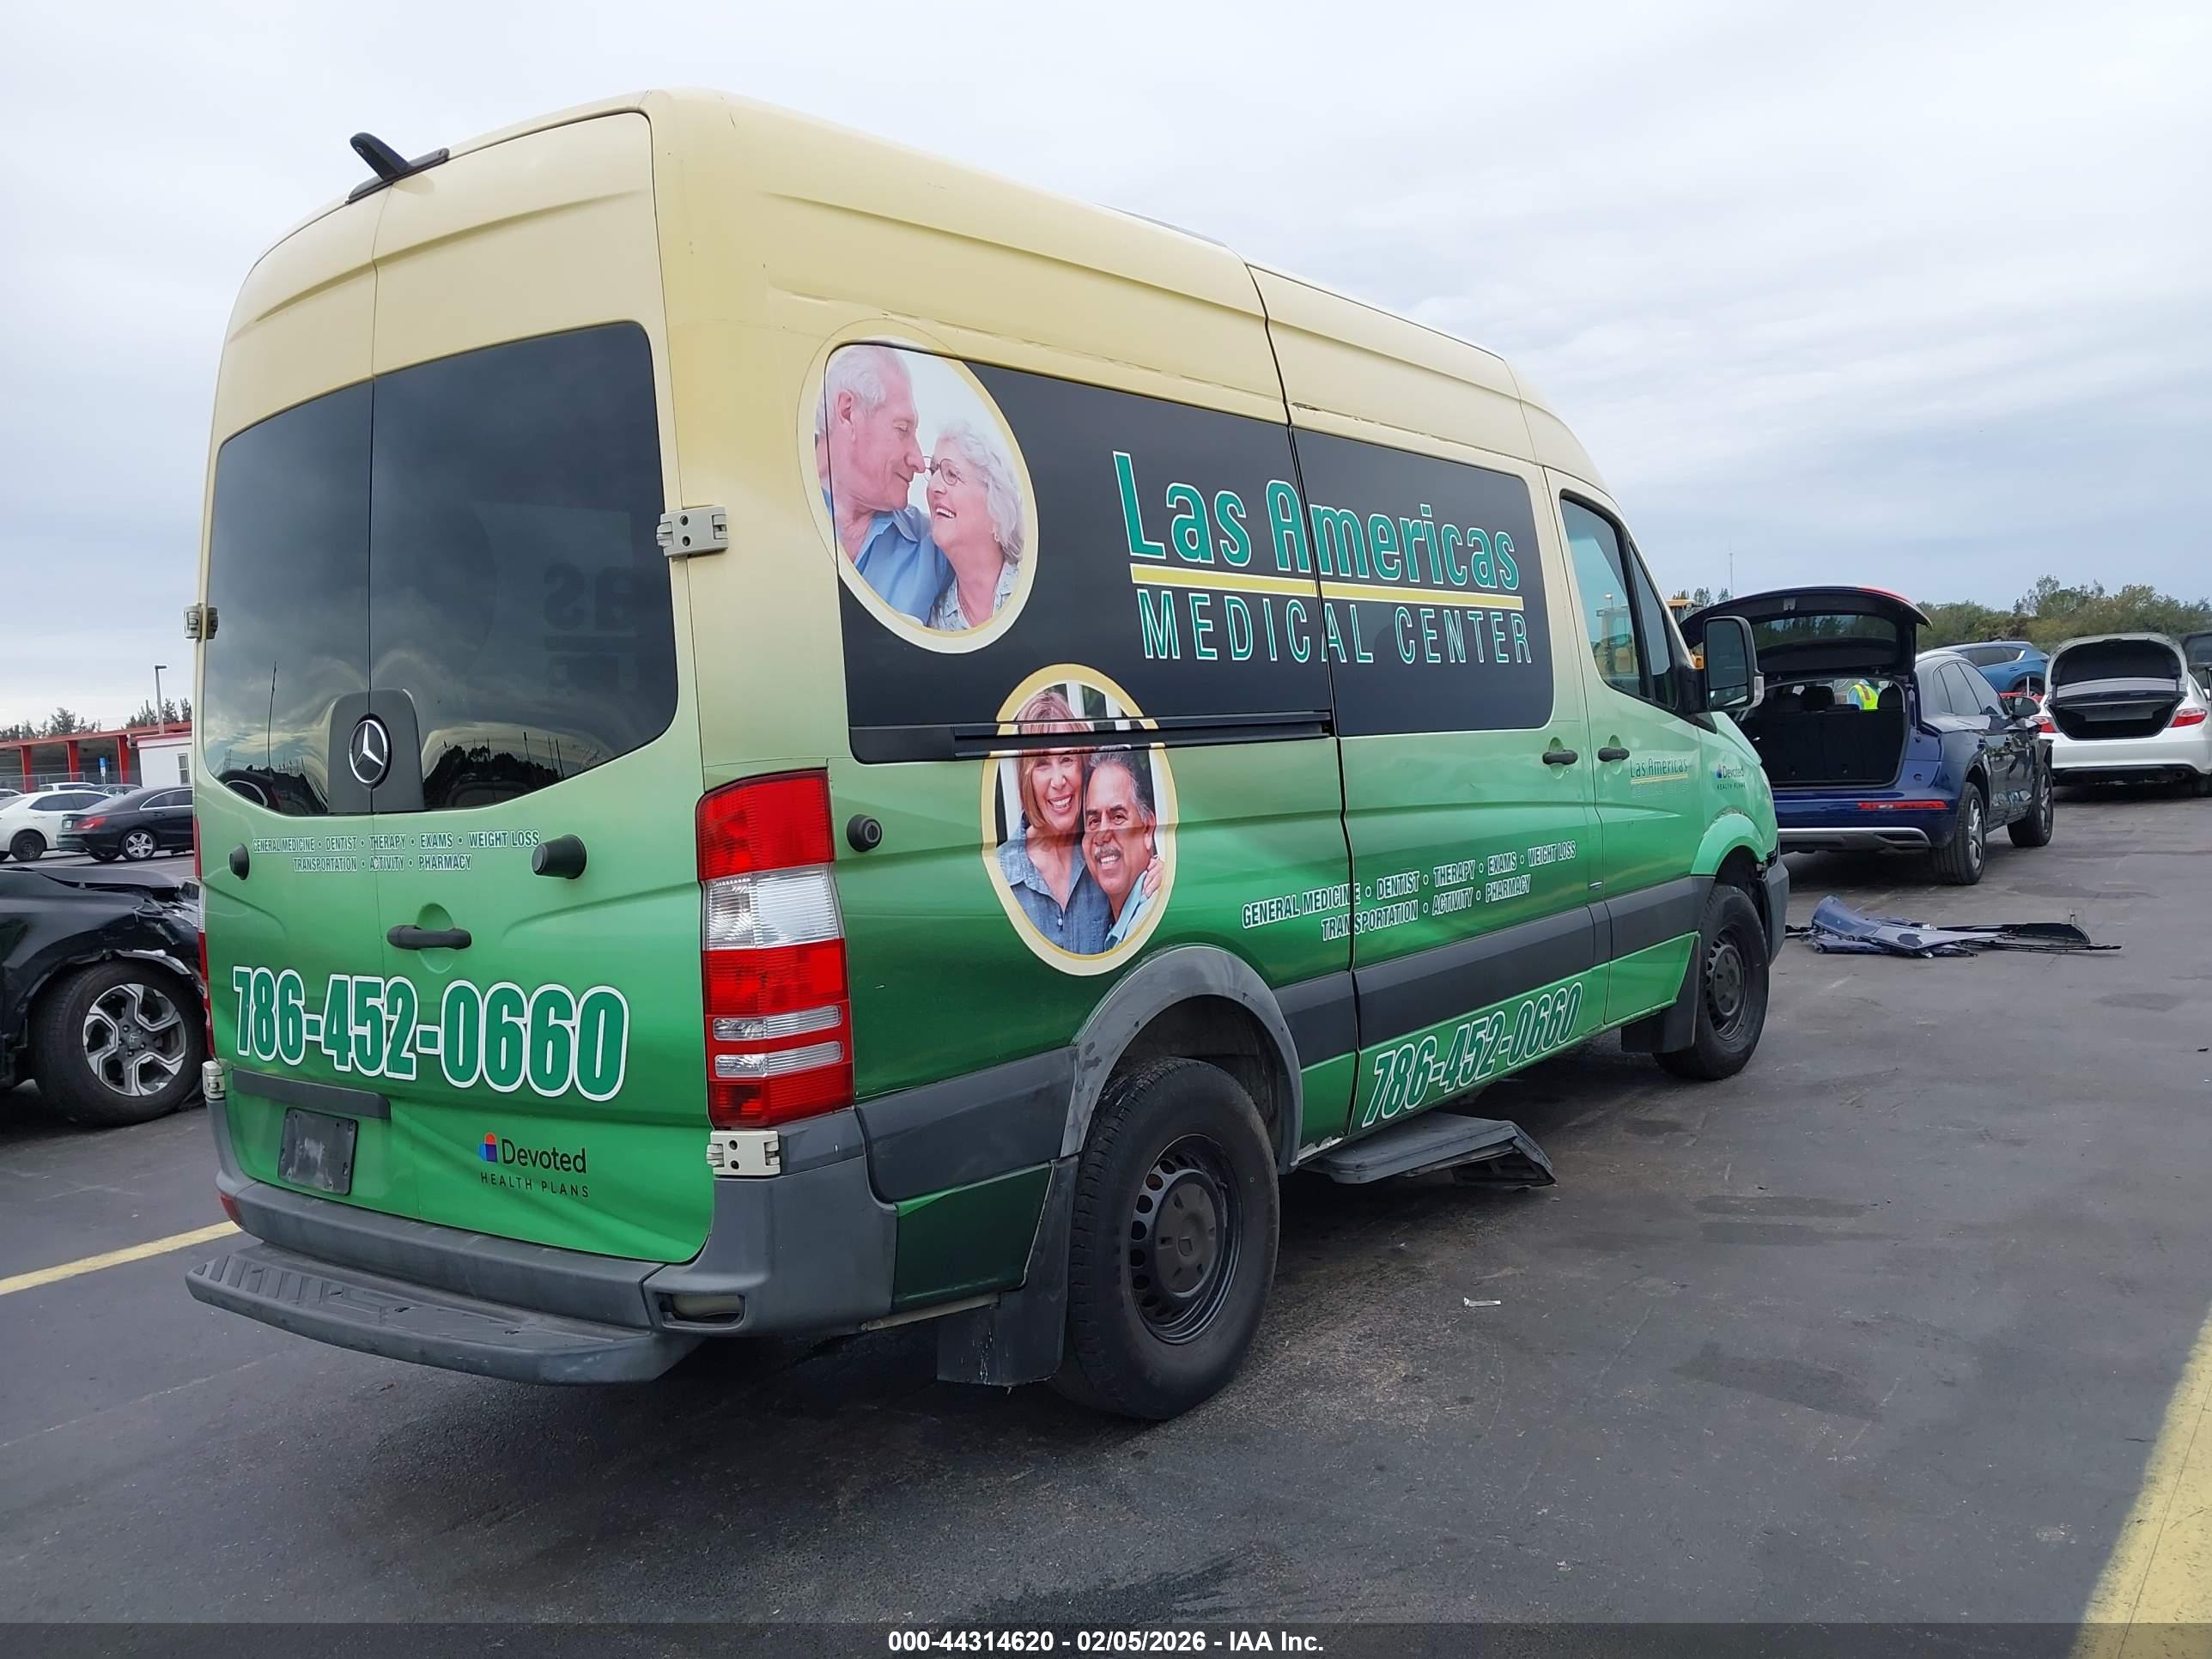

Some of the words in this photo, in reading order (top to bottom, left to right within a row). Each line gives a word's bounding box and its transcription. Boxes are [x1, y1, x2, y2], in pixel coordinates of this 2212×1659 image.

[1113, 450, 1251, 568] Las
[1266, 479, 1519, 591] Americas
[1136, 588, 1374, 664] MEDICAL
[1395, 606, 1533, 665] CENTER
[1630, 760, 1646, 778] Las
[1649, 758, 1689, 776] Americas
[252, 838, 281, 853] GENERAL
[282, 836, 315, 852] MEDICINE
[325, 836, 357, 851] DENTIST
[369, 833, 406, 850] THERAPY
[419, 832, 453, 848] EXAMS
[468, 831, 509, 848] WEIGHT
[510, 830, 540, 848] LOSS
[294, 856, 358, 872] TRANSPORTATION
[369, 854, 405, 871] ACTIVITY
[418, 854, 472, 871] PHARMACY
[1243, 895, 1300, 929] GENERAL
[1302, 883, 1361, 915] MEDICINE
[1376, 871, 1420, 900] DENTIST
[1433, 860, 1475, 887] THERAPY
[1487, 852, 1517, 876] EXAMS
[1528, 843, 1557, 867] WEIGHT
[1557, 840, 1577, 861] LOSS
[1322, 899, 1419, 941] TRANSPORTATION
[1432, 887, 1474, 916] ACTIVITY
[1486, 874, 1532, 902] PHARMACY
[233, 965, 629, 1102] 786-452-0660
[1361, 981, 1583, 1128] 786-452-0660
[480, 1172, 534, 1191] HEALTH
[541, 1181, 591, 1199] PLANS
[501, 1138, 587, 1175] Devoted
